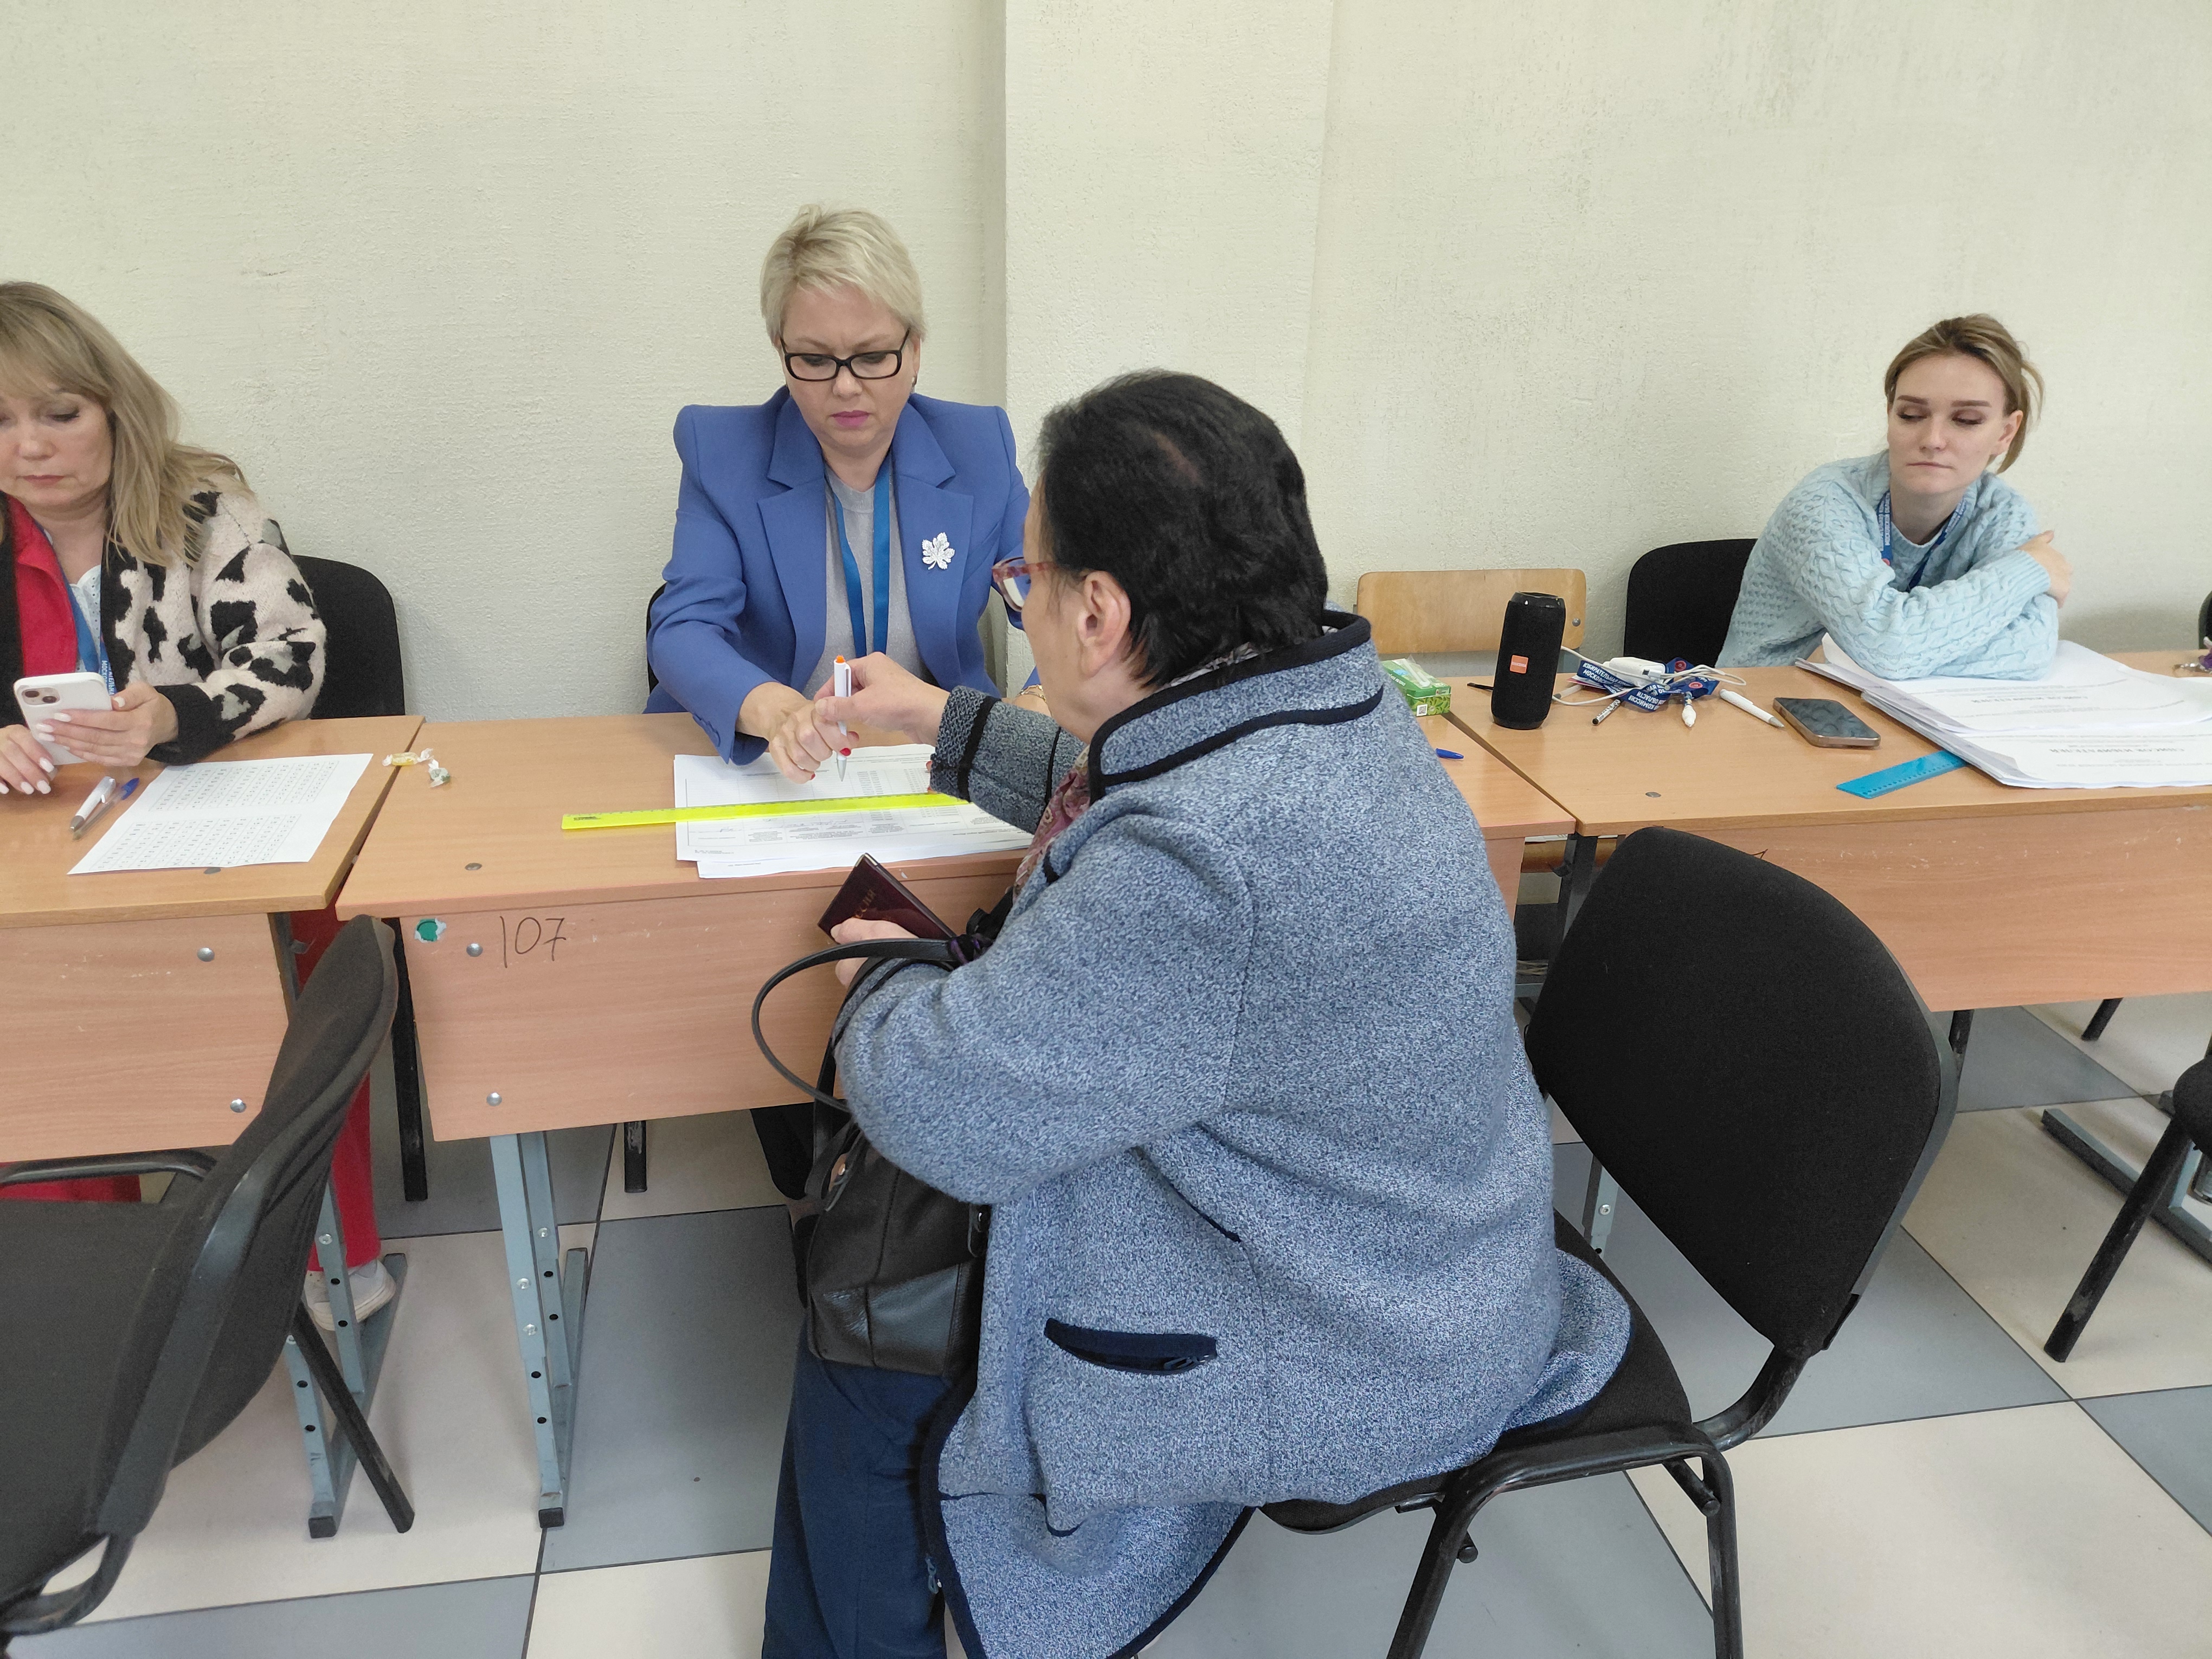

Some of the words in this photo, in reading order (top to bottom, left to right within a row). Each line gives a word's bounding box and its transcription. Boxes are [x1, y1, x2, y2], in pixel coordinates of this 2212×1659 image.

[1628, 695, 1655, 710] КОМИССИЯ
[1636, 691, 1659, 704] ОБЛАСТИ
[499, 916, 567, 968] 107
